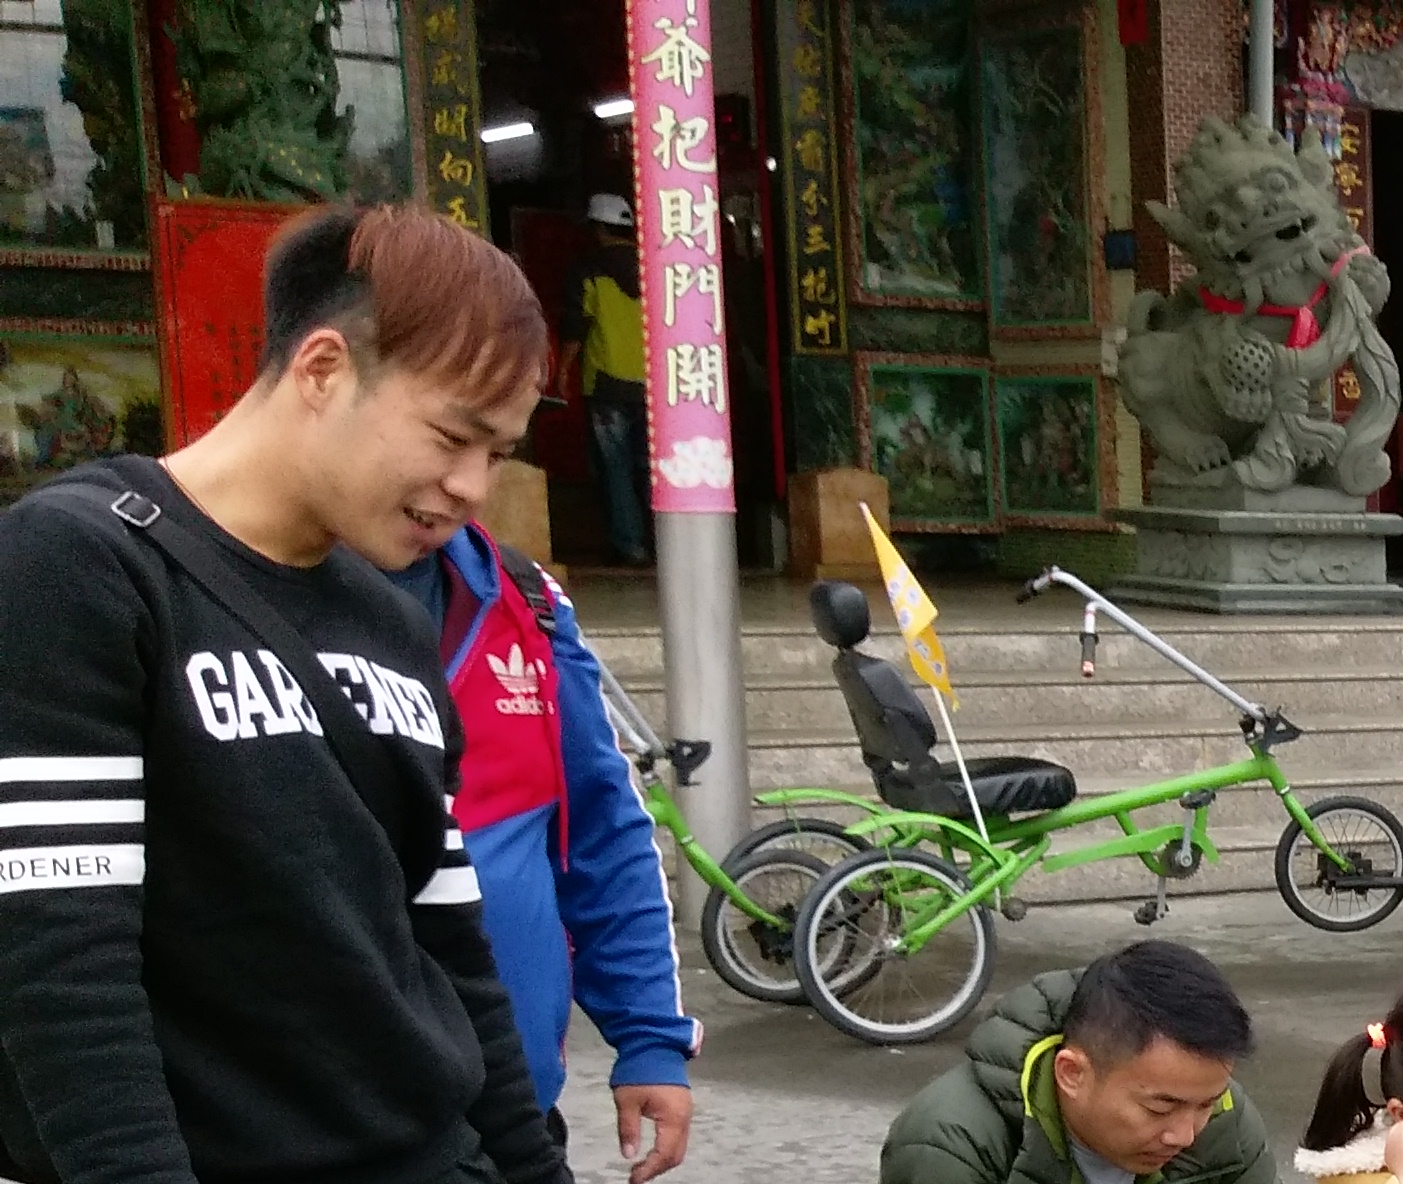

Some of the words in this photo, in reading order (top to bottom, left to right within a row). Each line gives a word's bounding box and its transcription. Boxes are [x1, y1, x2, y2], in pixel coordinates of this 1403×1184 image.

[640, 0, 727, 415] 爺把財門開
[186, 649, 445, 750] GARENER
